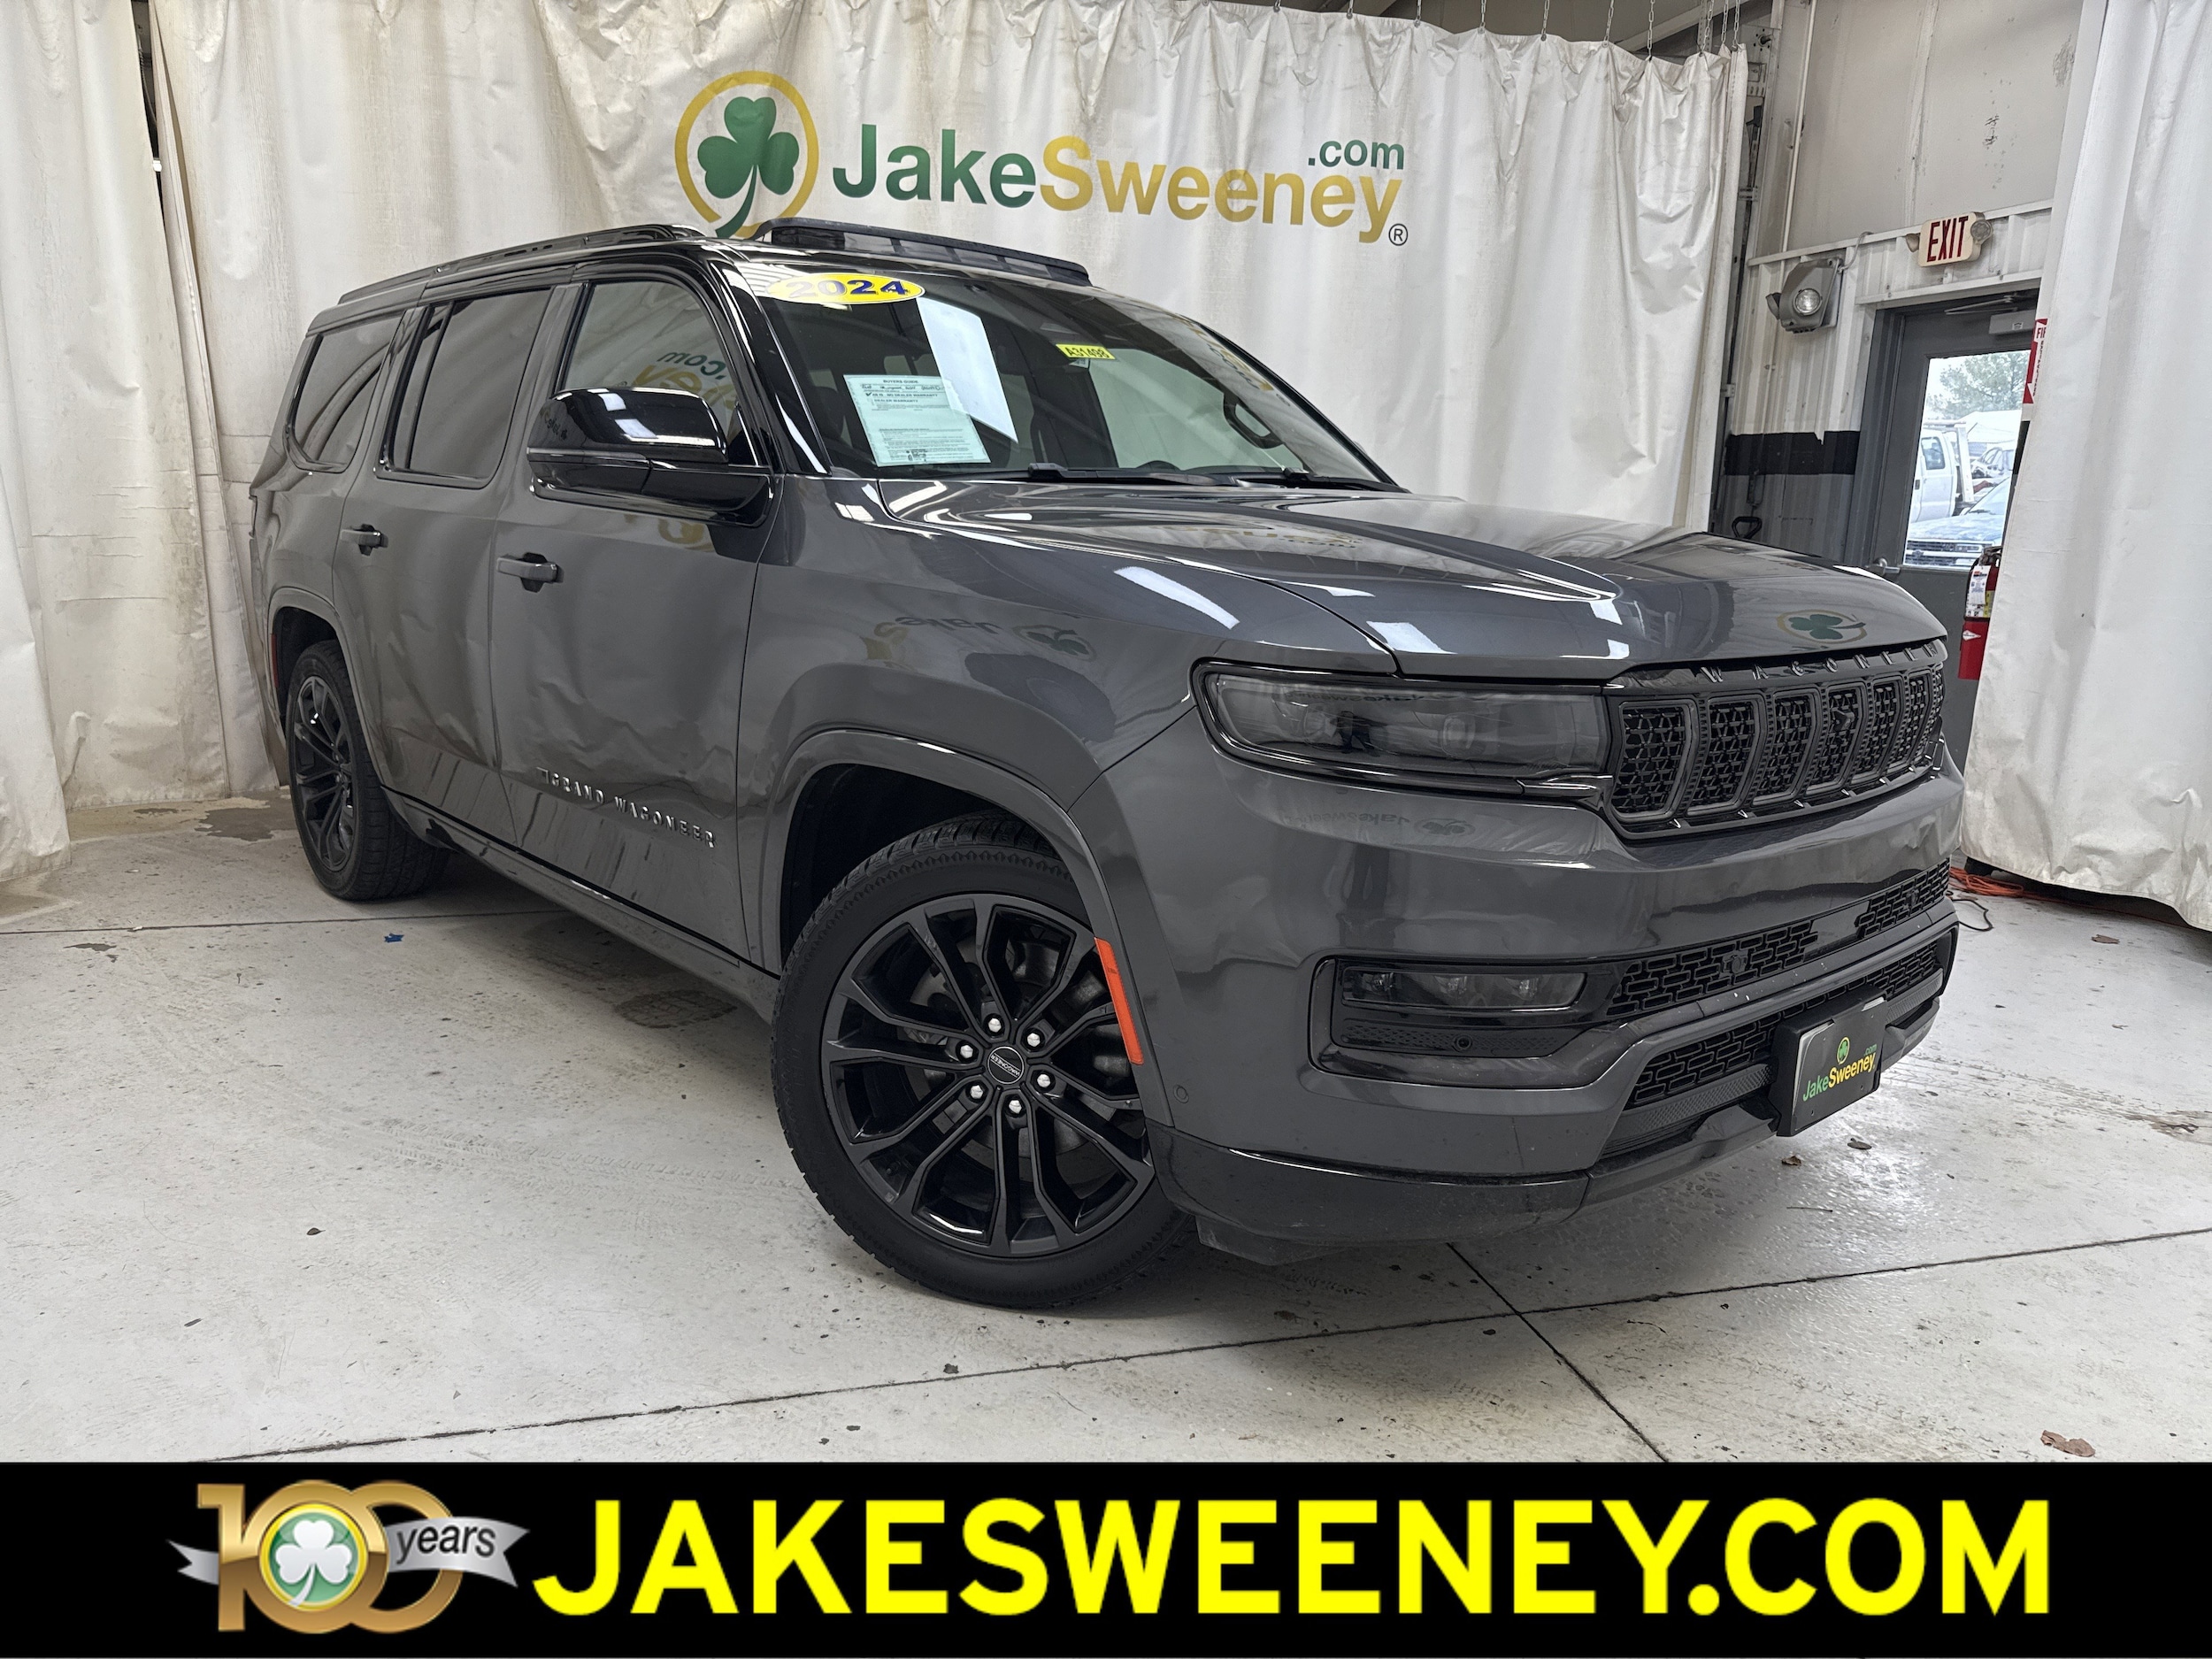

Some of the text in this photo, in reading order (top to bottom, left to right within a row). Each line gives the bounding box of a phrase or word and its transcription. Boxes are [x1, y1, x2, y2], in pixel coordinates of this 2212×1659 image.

[1308, 140, 1404, 170] .com
[832, 123, 1403, 243] JakeSweeney
[1926, 215, 1969, 262] EXIT
[786, 280, 911, 299] 2024
[551, 772, 716, 849] GRAND WAGONEER
[991, 1053, 1021, 1076] WAGONEER
[1863, 1043, 1878, 1056] .com
[1802, 1052, 1877, 1102] JakeSweeney
